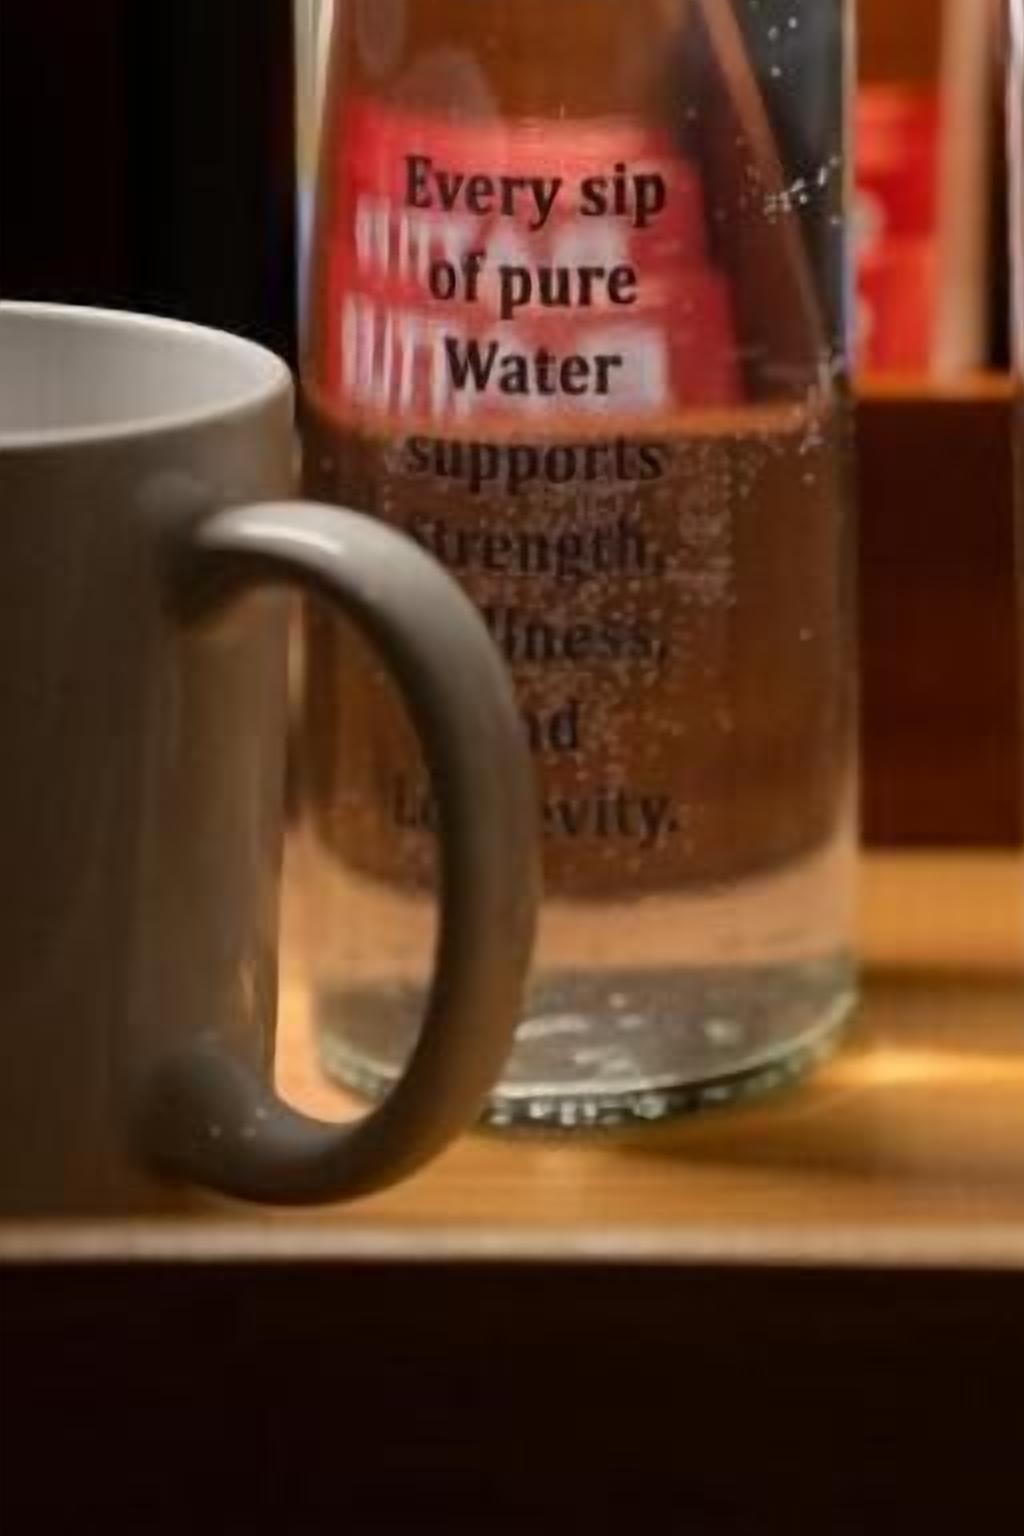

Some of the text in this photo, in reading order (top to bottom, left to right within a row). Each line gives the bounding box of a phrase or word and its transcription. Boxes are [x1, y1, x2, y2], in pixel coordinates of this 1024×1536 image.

[403, 154, 667, 232] Every sip
[427, 250, 638, 321] of pure
[443, 335, 624, 397] Water
[405, 435, 668, 492] supports
